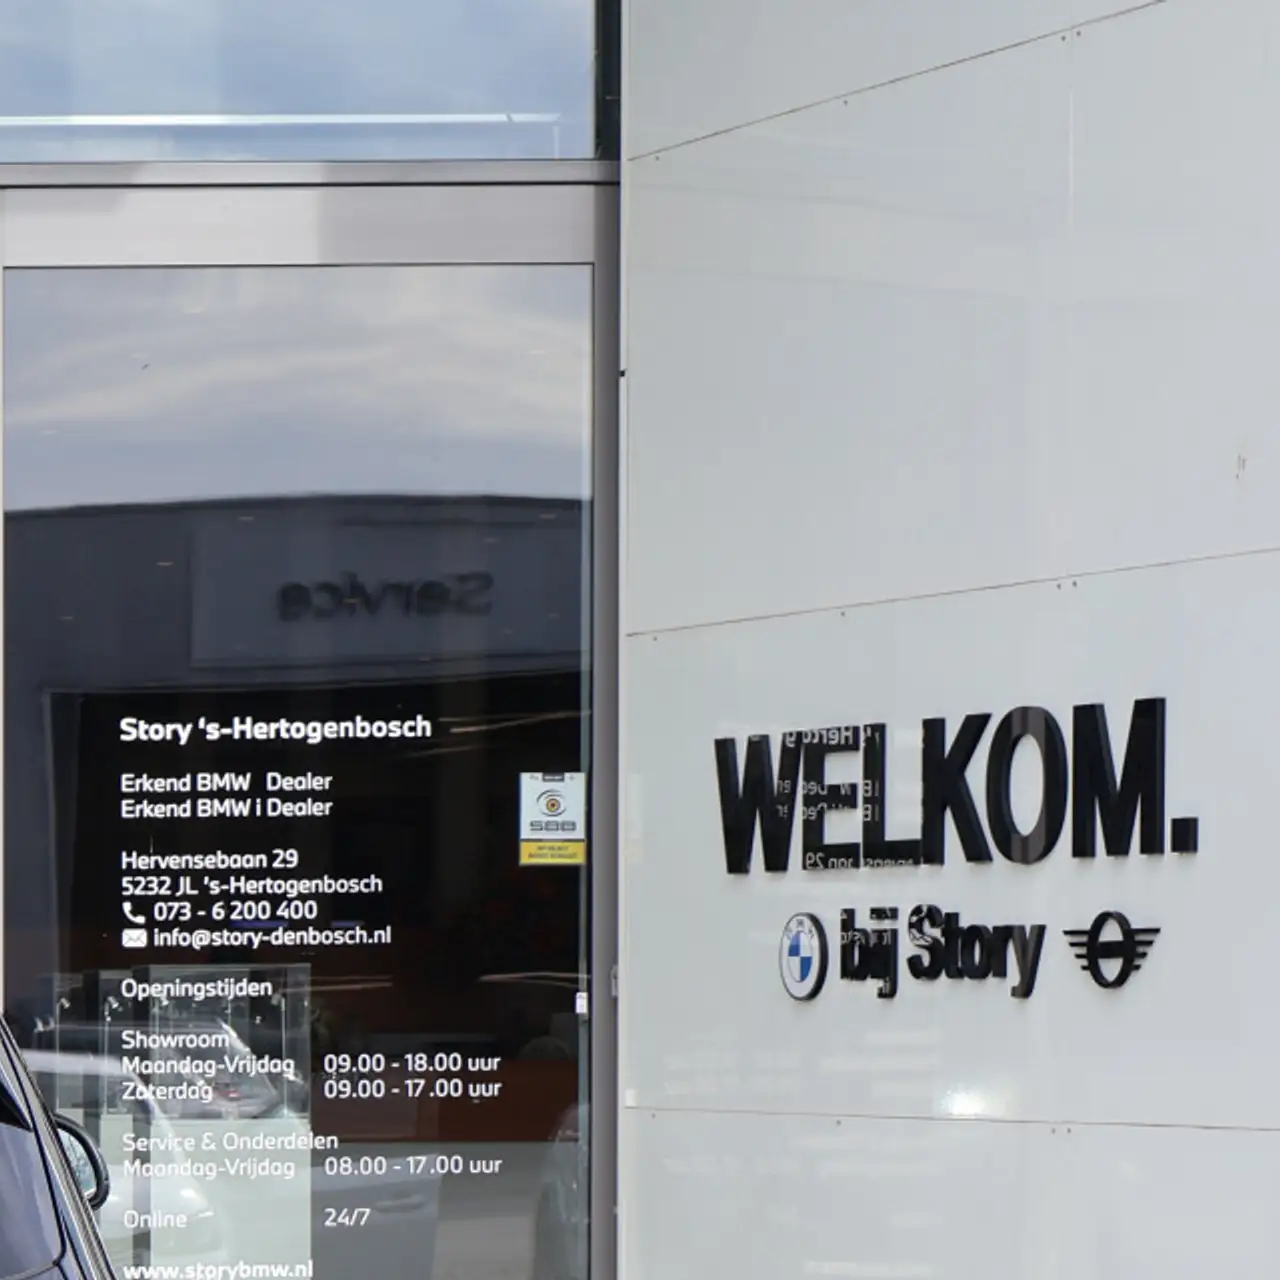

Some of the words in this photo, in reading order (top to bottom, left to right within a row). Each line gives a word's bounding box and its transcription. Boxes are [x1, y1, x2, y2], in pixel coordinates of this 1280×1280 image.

[119, 717, 193, 746] Story
[120, 773, 192, 794] Erkend
[196, 772, 251, 793] BMW
[265, 772, 333, 792] Dealer
[714, 696, 1199, 874] WELKOM.
[120, 798, 192, 819] Erkend
[196, 798, 251, 818] BMW
[255, 798, 262, 818] i
[265, 797, 333, 818] Dealer
[121, 850, 267, 871] Hervensebaan
[271, 849, 299, 868] 29
[121, 876, 172, 896] 5232
[176, 875, 199, 896] JL
[153, 902, 192, 921] 073
[211, 901, 225, 921] 6
[230, 901, 272, 920] 200
[276, 900, 318, 920] 400
[153, 927, 392, 950] info@story-denbosch.nl
[840, 907, 899, 999] bij
[907, 905, 1048, 999] Story
[120, 978, 273, 1003] Openingstijden
[121, 1030, 230, 1050] Showroom
[121, 1055, 295, 1080] Maandag-Vrijdag
[323, 1053, 386, 1074] 09.00
[403, 1052, 463, 1072] 18.00
[467, 1055, 502, 1072] uur
[121, 1081, 213, 1105] Zaterdag
[324, 1079, 386, 1099] 09.00
[468, 1081, 502, 1098] uur
[122, 1133, 196, 1153] Service
[201, 1132, 217, 1152] &
[222, 1131, 339, 1150] Onderdelen
[123, 1158, 295, 1183] Maandag-Vrijdag
[324, 1156, 387, 1177] 08.00
[468, 1157, 503, 1175] uur
[123, 1209, 187, 1229] Online
[324, 1207, 371, 1228] 24/7
